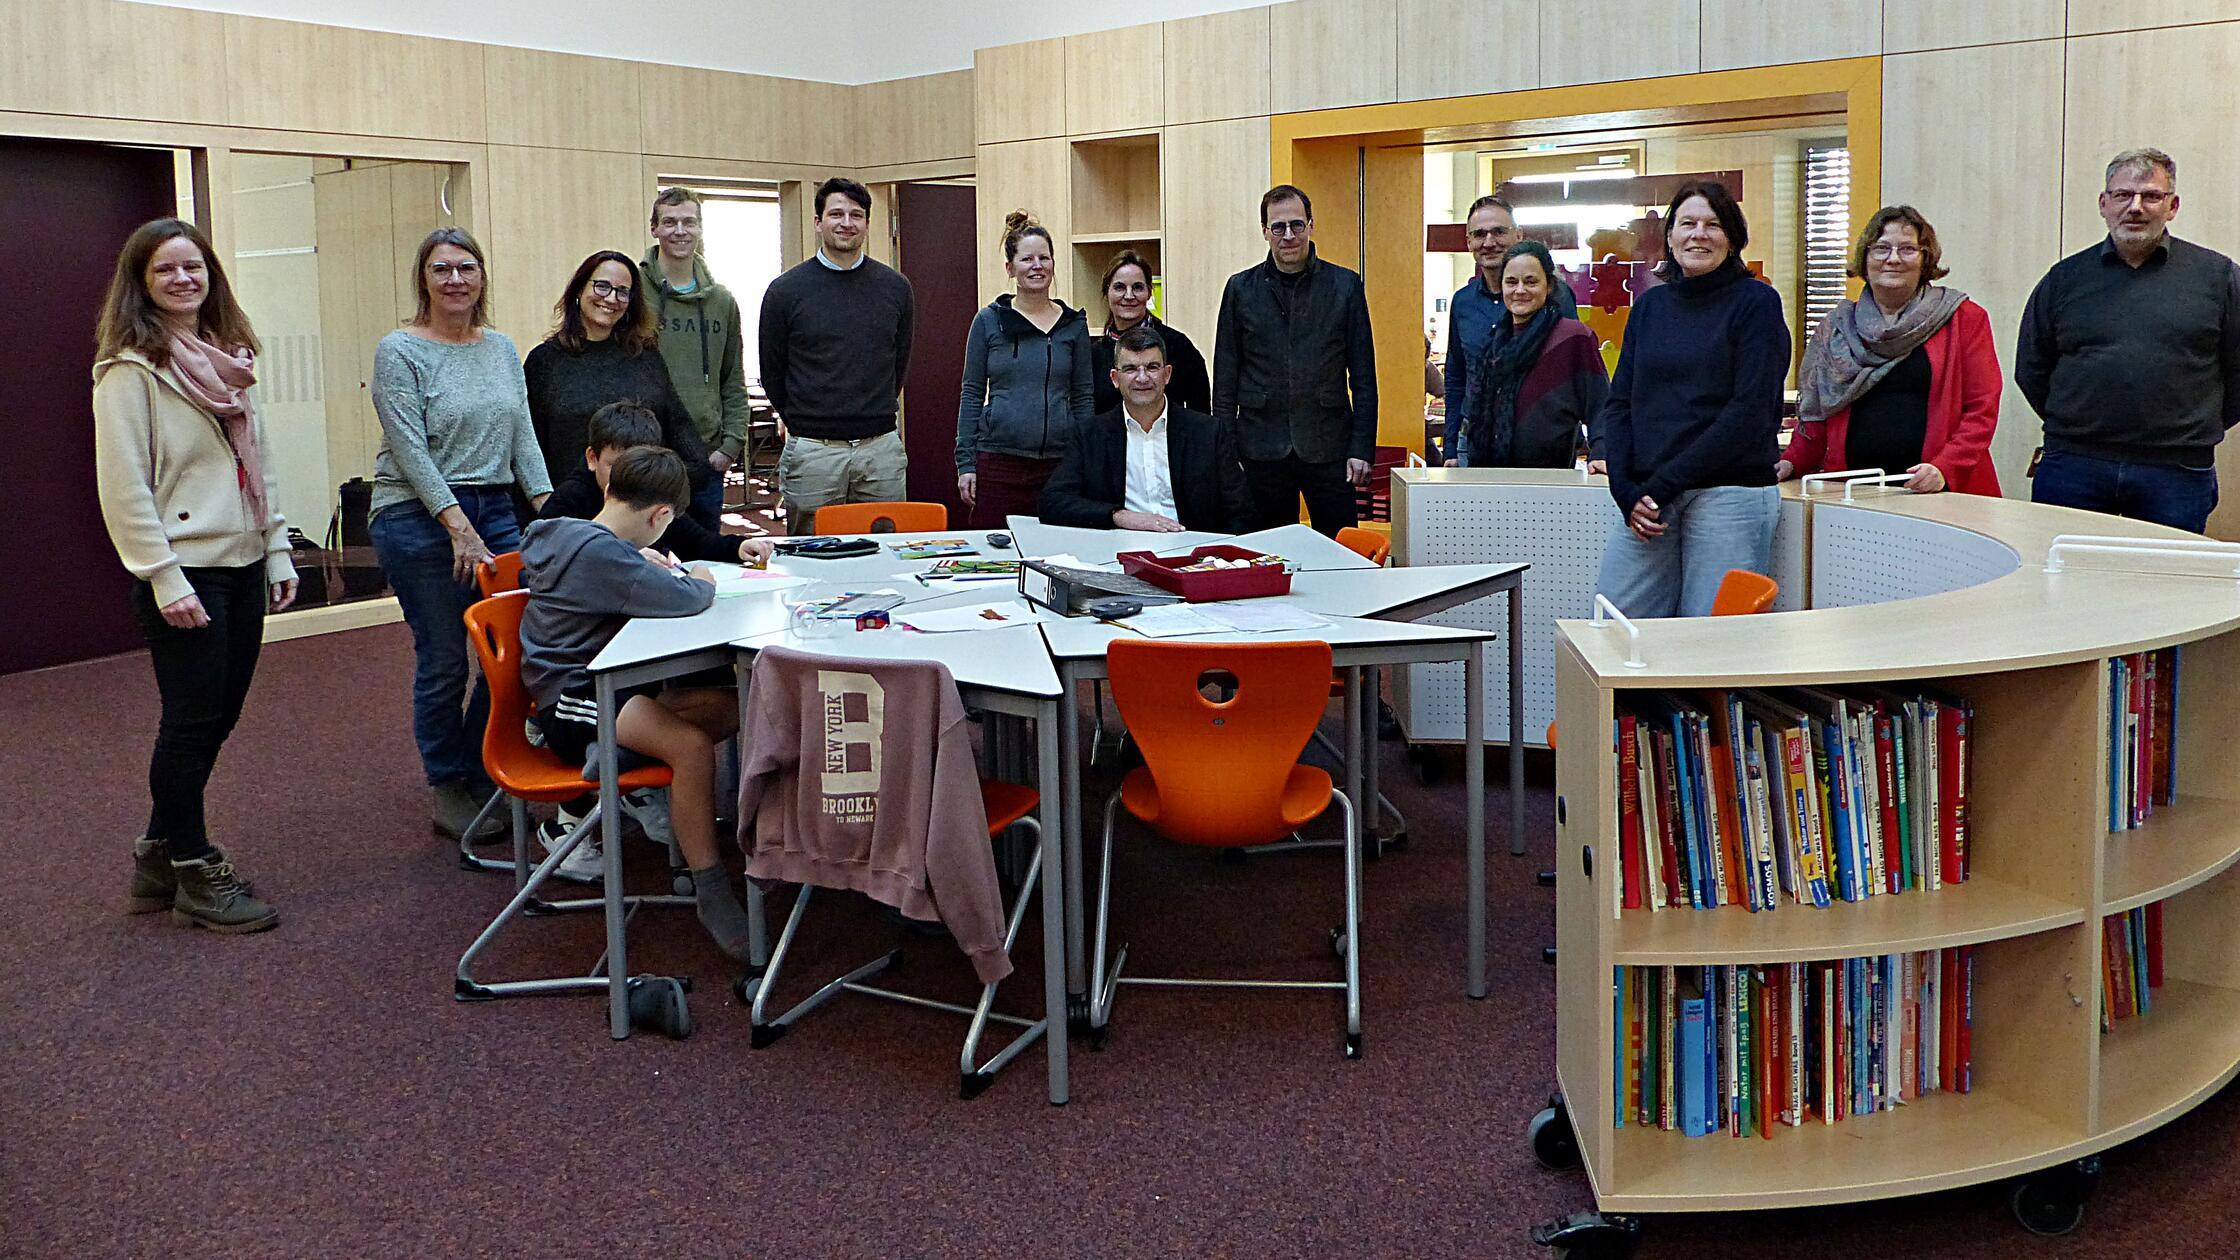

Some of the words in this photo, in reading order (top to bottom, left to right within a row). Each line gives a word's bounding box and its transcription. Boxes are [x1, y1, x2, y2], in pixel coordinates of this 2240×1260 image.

[827, 694, 843, 733] YORK
[828, 739, 844, 775] NEW
[1622, 731, 1635, 764] Busch
[1622, 768, 1636, 815] Wilhelm
[836, 815, 845, 824] TO
[846, 814, 875, 823] NEWARK
[1798, 813, 1806, 827] und
[1799, 827, 1808, 847] Natur
[1764, 864, 1775, 906] KOSMOS
[1739, 1022, 1749, 1047] Spaß
[1739, 1052, 1747, 1066] mit
[1740, 1071, 1748, 1100] Natur
